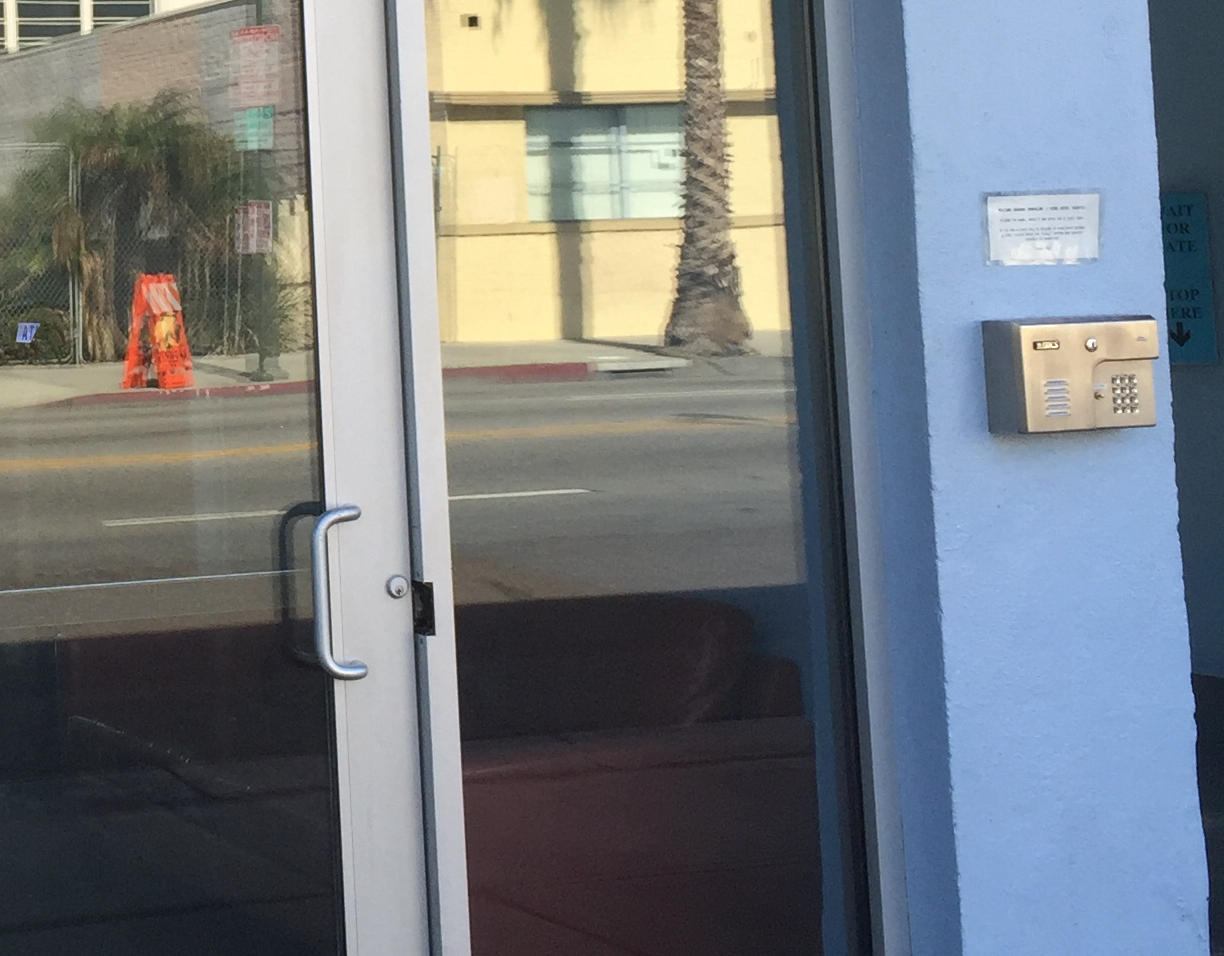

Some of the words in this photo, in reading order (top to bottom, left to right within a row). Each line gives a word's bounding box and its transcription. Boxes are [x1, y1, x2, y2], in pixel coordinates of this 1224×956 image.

[1163, 204, 1194, 218] AIT
[1166, 222, 1191, 235] OR
[1167, 240, 1198, 253] ATE
[1169, 288, 1200, 302] TOP
[1170, 306, 1203, 320] ERE
